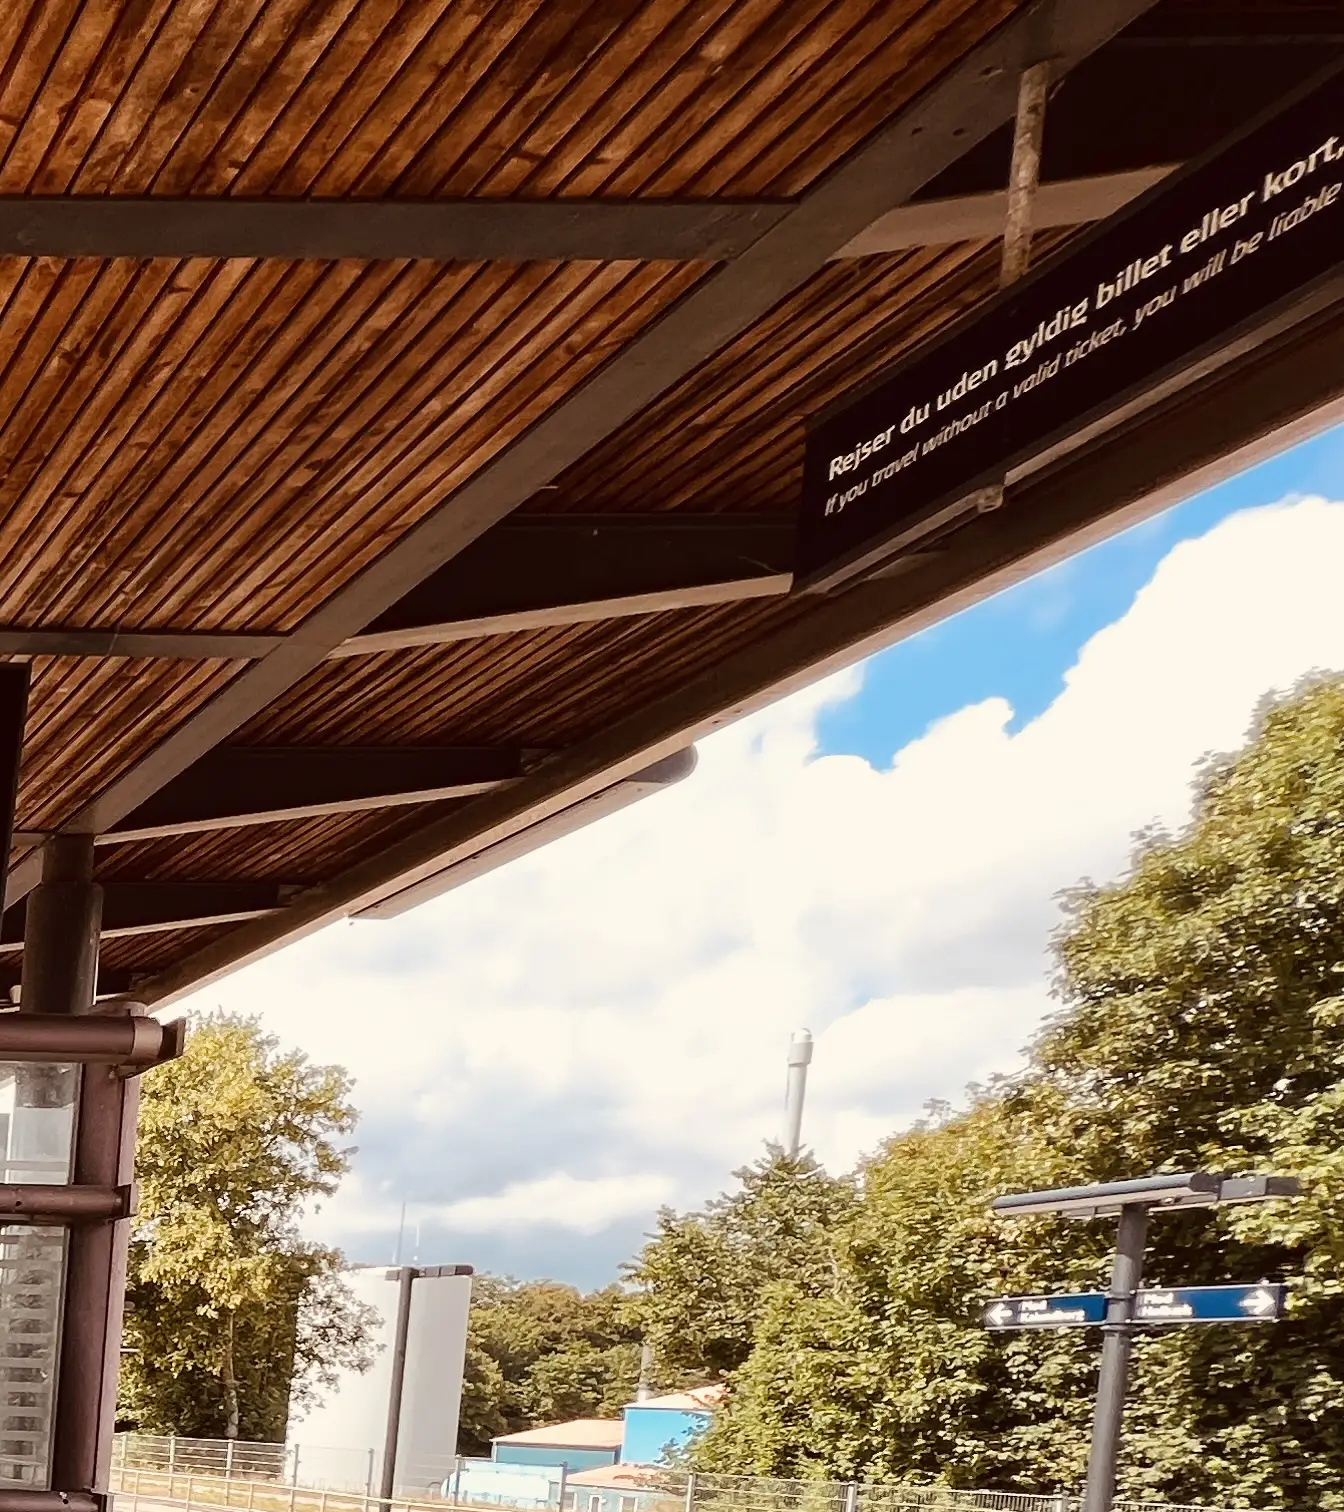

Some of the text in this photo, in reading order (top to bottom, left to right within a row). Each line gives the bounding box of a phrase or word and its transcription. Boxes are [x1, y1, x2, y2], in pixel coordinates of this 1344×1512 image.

[825, 182, 1342, 516] If you travel without a valid ticket, you will be liable
[828, 424, 896, 481] Rejser
[900, 402, 931, 434] du
[936, 359, 999, 411] uden
[1004, 297, 1089, 370] gyldig
[1096, 244, 1173, 310] billet
[1180, 191, 1255, 254] eller
